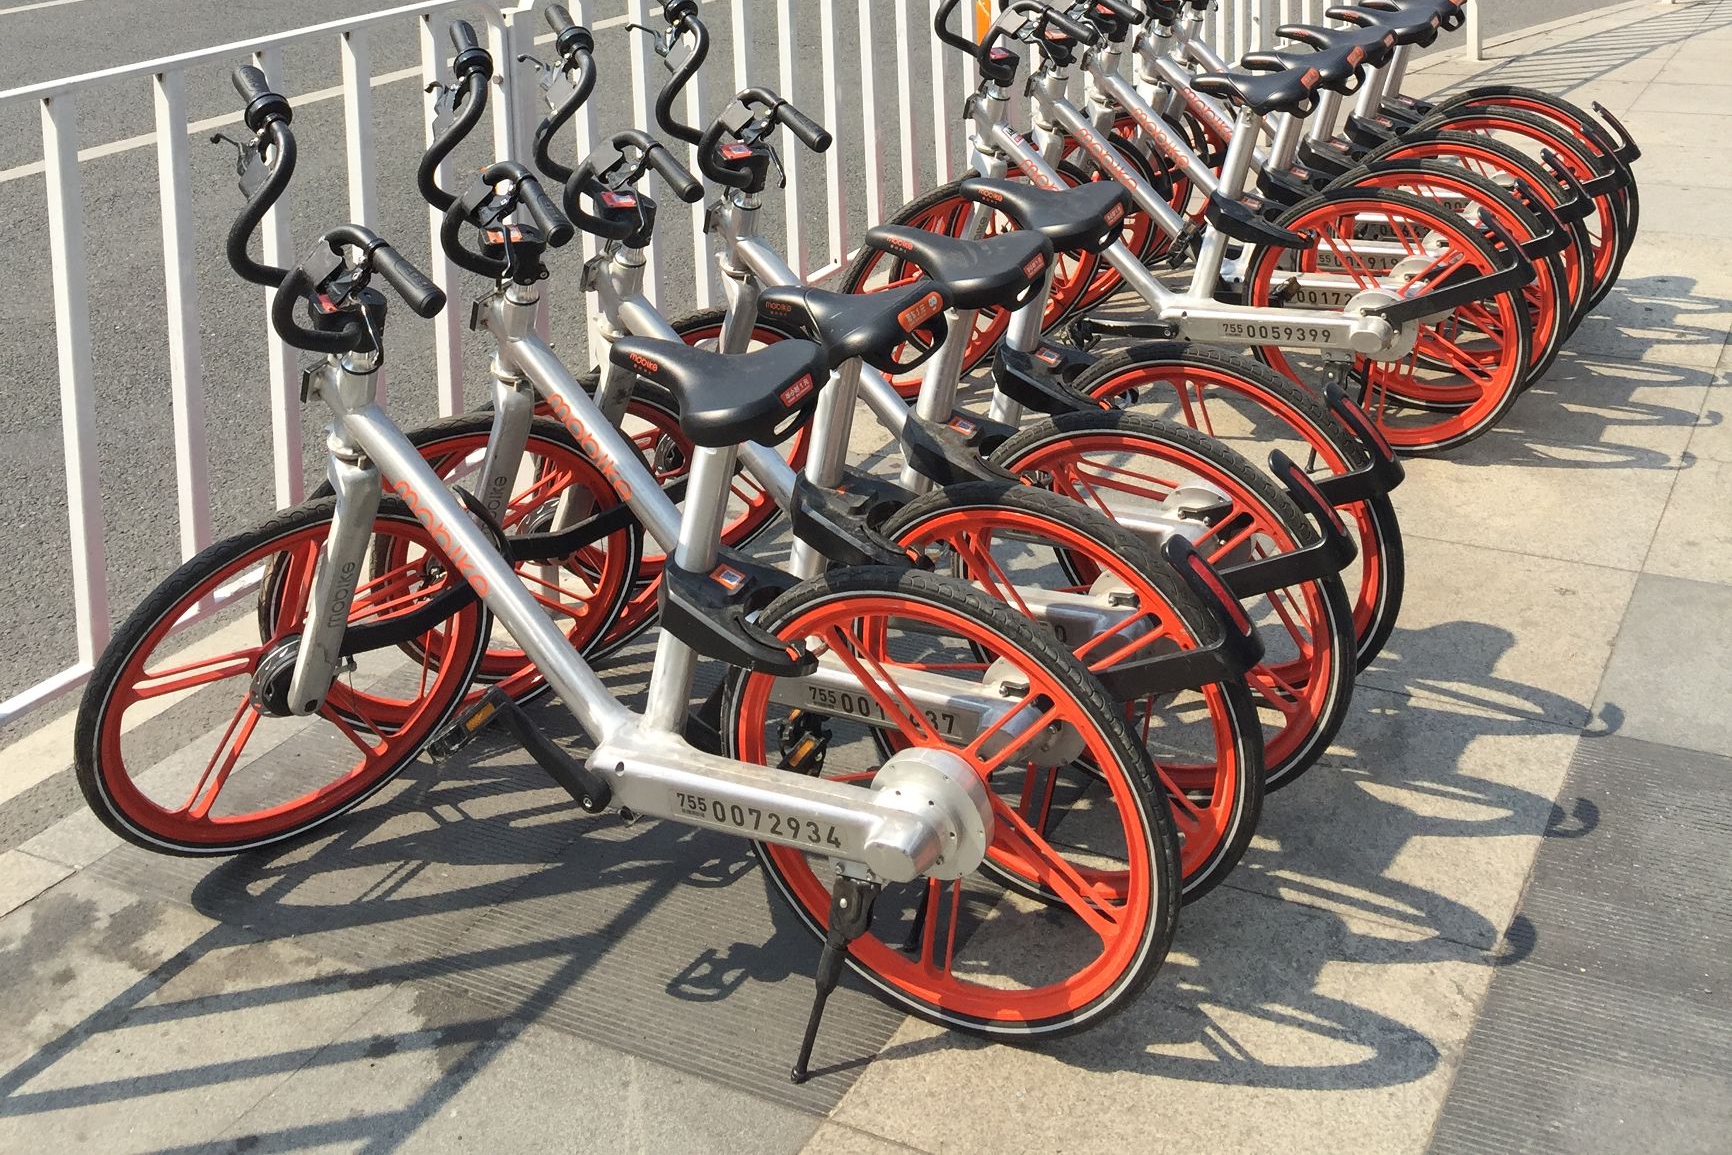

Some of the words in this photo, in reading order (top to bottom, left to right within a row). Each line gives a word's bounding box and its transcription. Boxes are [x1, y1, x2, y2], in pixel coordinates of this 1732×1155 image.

[1074, 128, 1137, 191] mobike
[1131, 108, 1189, 169] mobike
[1222, 323, 1243, 334] 755
[1247, 325, 1331, 343] 0059399
[548, 393, 633, 500] mobike
[394, 480, 489, 597] mobike
[327, 561, 355, 628] mobike
[809, 686, 836, 704] 755
[676, 792, 707, 812] 755
[712, 800, 841, 848] 0072934
